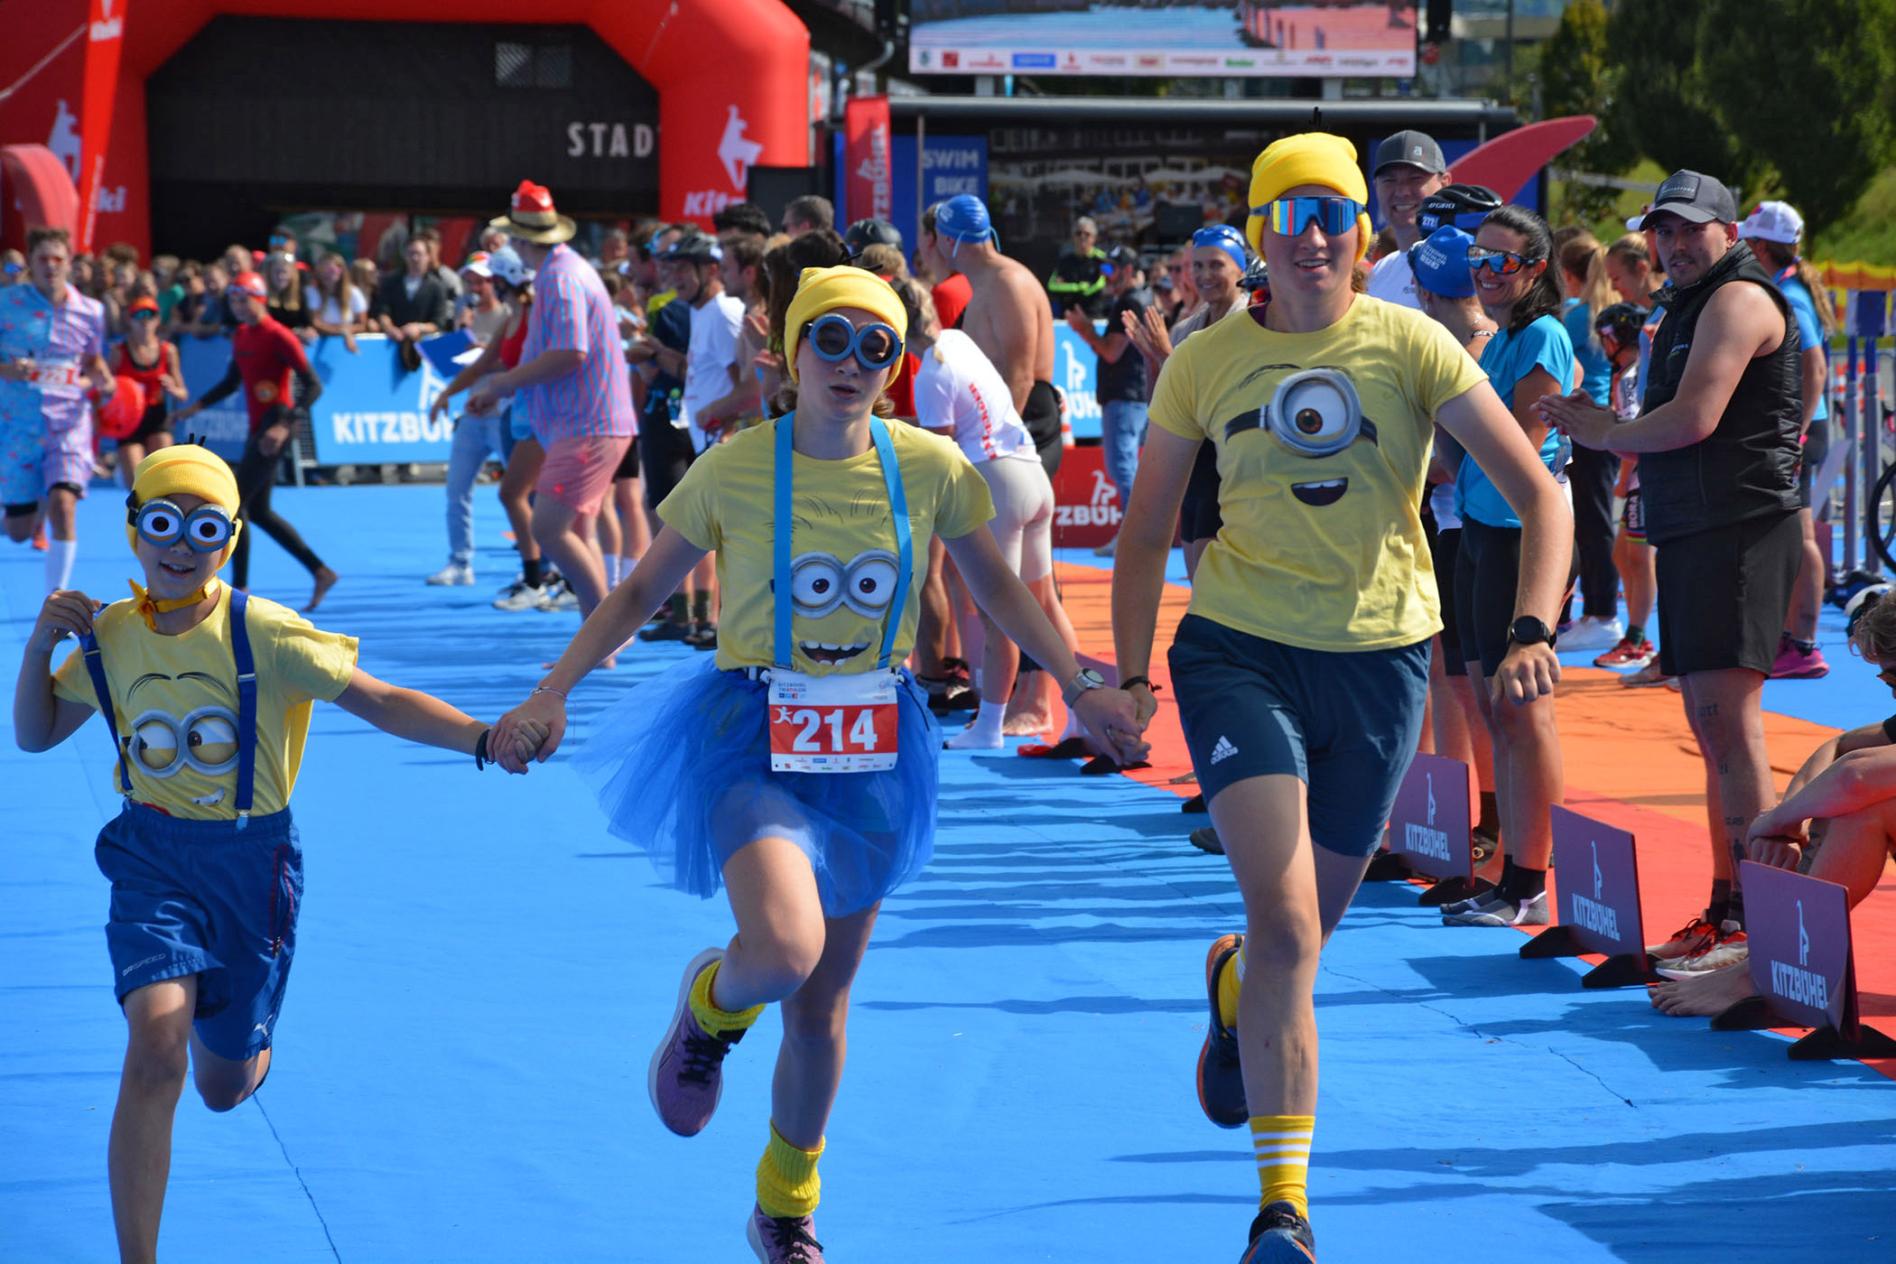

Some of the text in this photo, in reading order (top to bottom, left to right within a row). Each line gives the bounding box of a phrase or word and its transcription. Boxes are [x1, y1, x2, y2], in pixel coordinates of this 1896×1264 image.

[566, 121, 662, 158] STAD
[923, 149, 979, 170] SWIM
[933, 175, 979, 196] BIKE
[792, 708, 878, 753] 214
